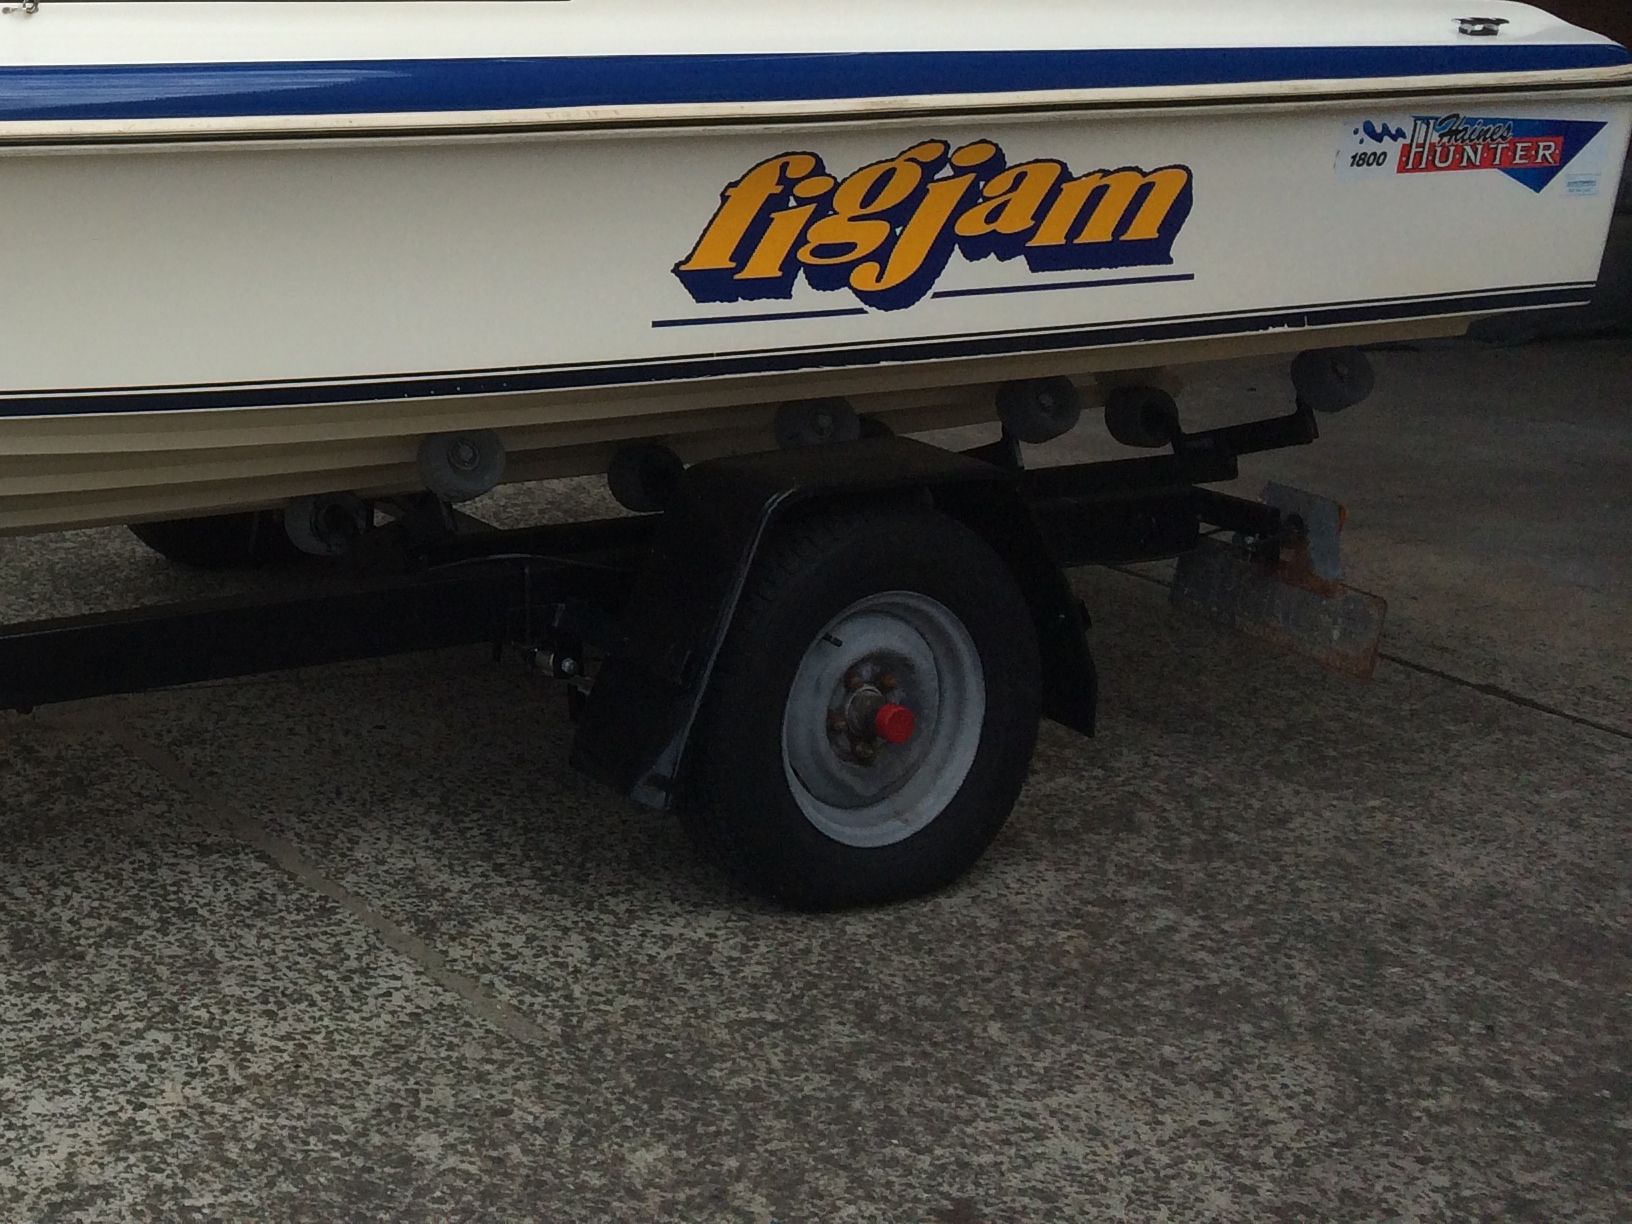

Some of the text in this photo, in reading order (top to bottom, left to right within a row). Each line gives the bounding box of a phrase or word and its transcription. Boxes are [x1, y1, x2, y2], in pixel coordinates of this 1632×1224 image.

[1404, 118, 1557, 170] HUNTER
[1436, 113, 1514, 145] Haines
[1349, 151, 1388, 168] 1800
[672, 139, 1195, 312] figjam
